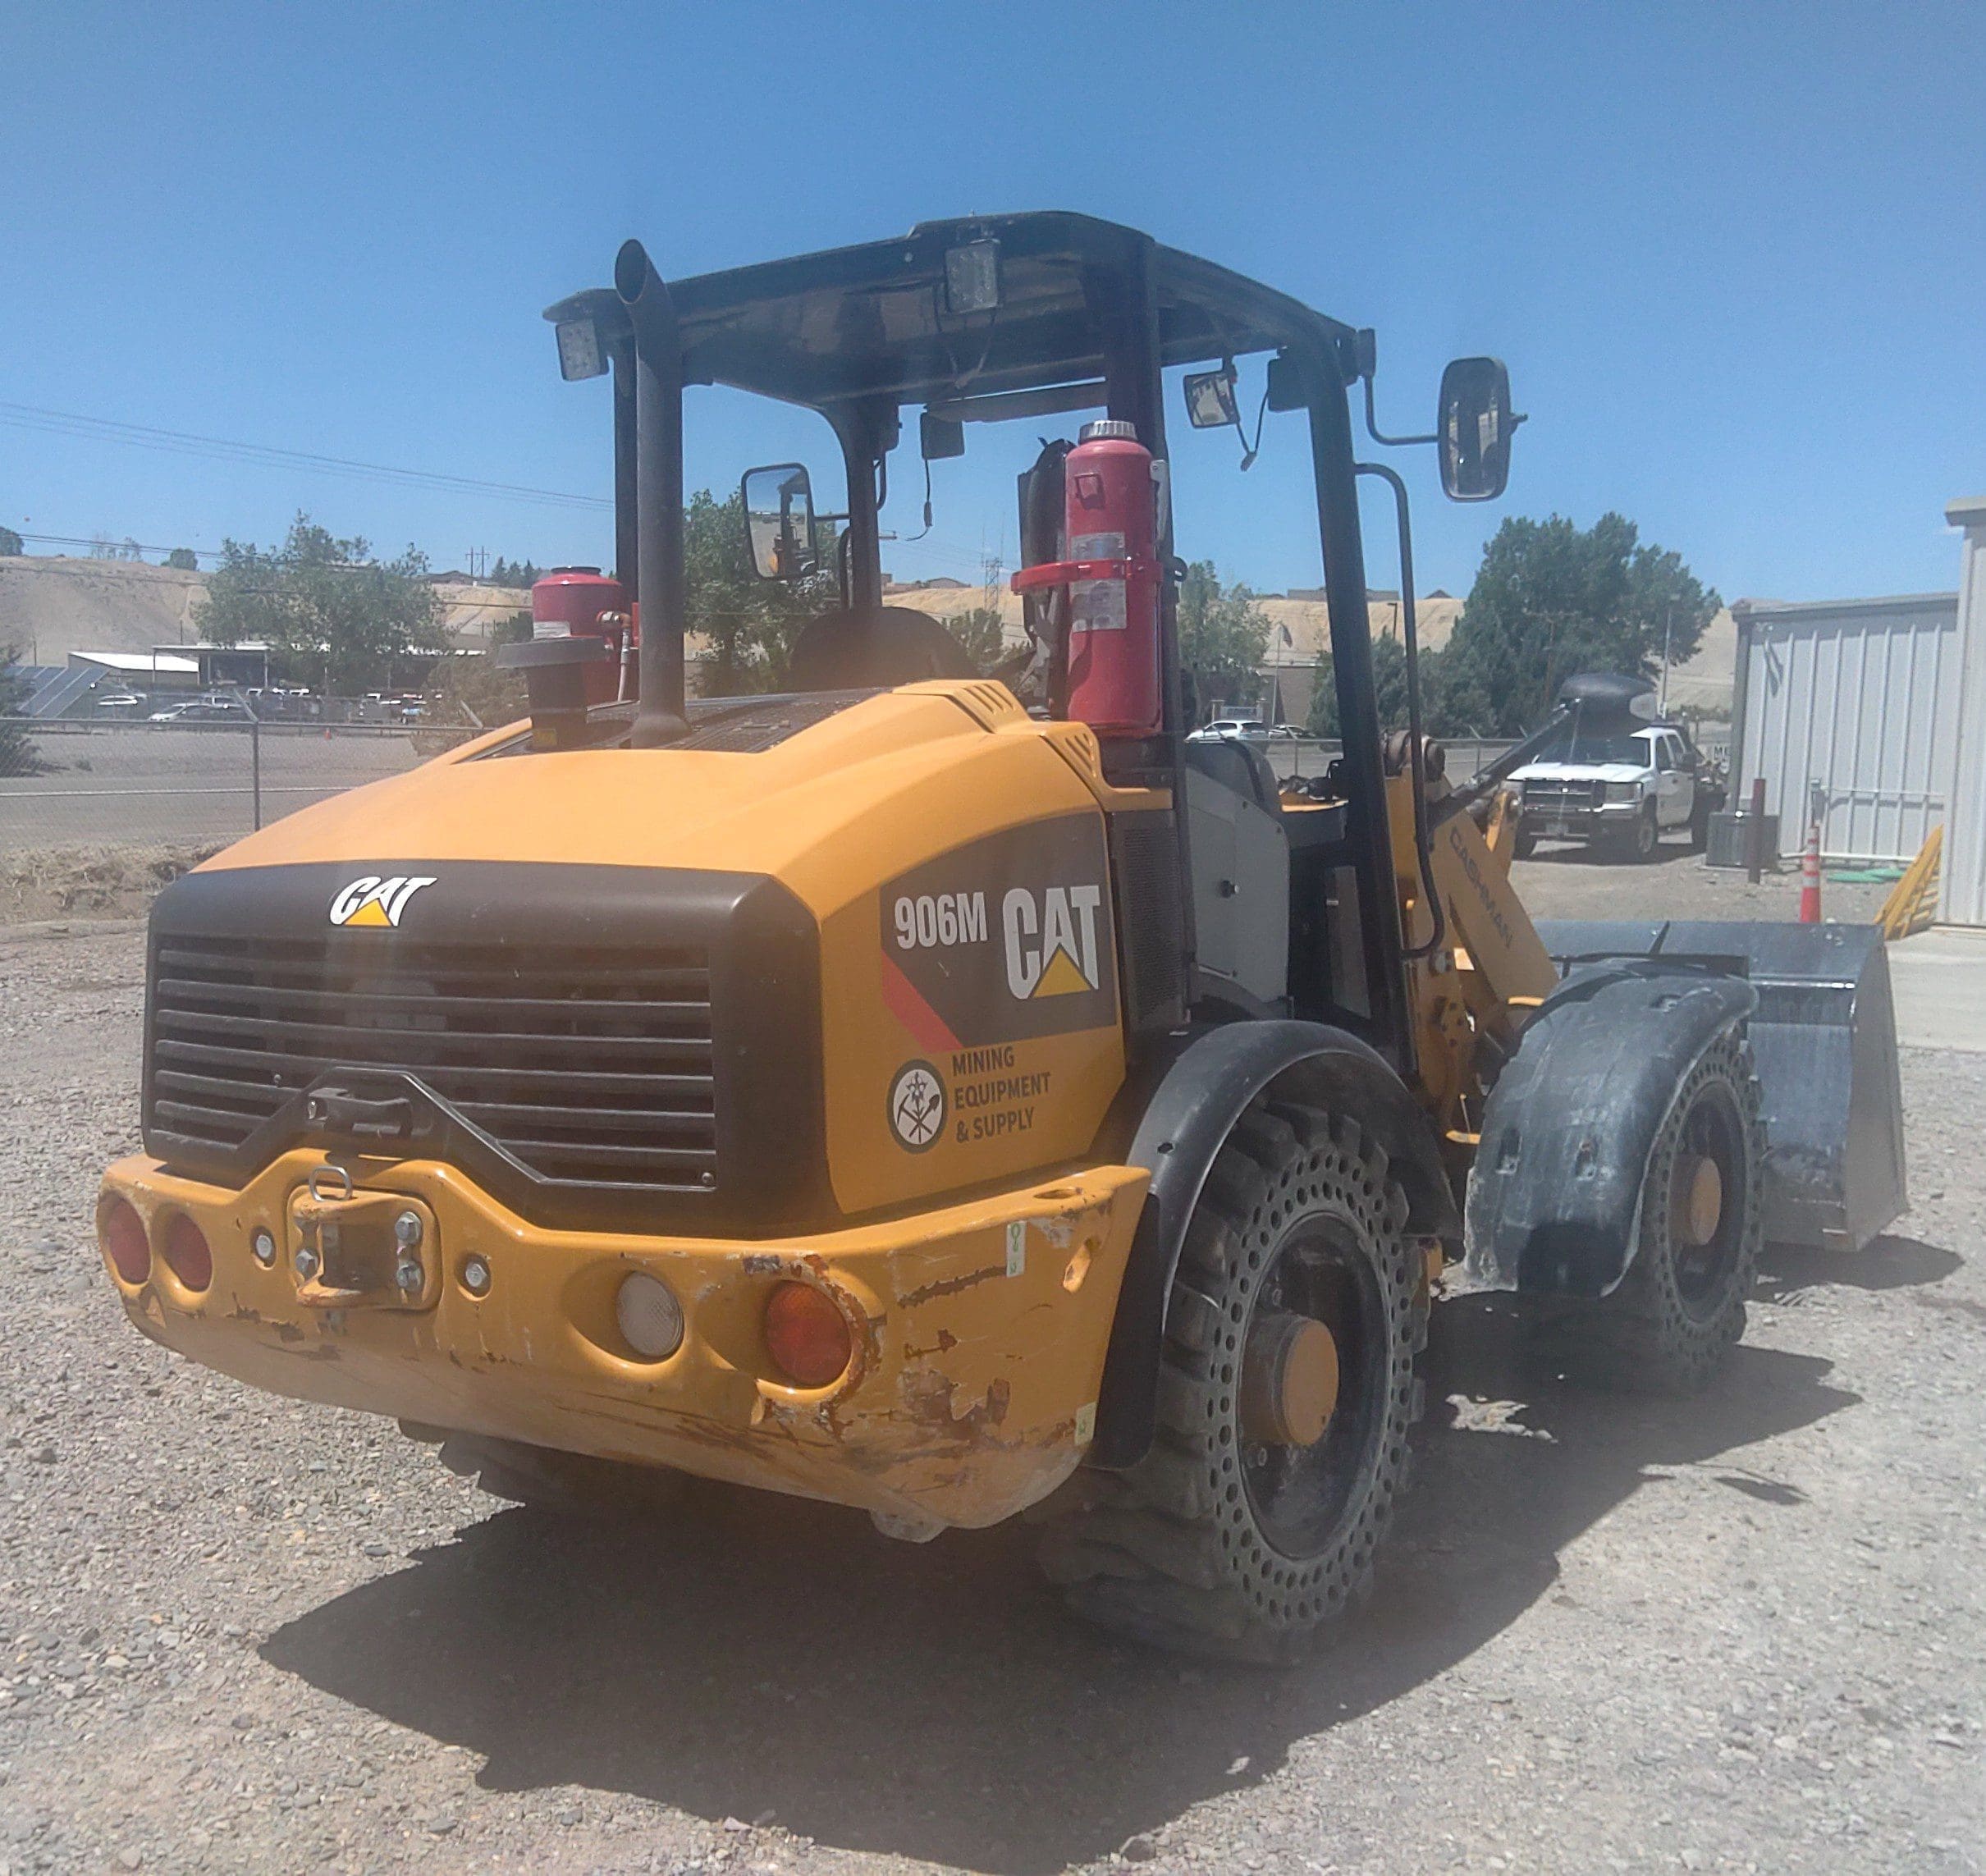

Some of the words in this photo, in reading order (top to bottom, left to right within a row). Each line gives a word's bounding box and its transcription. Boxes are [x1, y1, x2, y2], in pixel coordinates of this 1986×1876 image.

[330, 876, 437, 927] CAT
[895, 891, 987, 949] 906M
[1002, 885, 1101, 1000] CAT
[952, 1046, 1014, 1077] MINING
[954, 1071, 1050, 1110] EQUIPMENT
[956, 1120, 969, 1143] &
[972, 1106, 1034, 1140] SUPPLY
